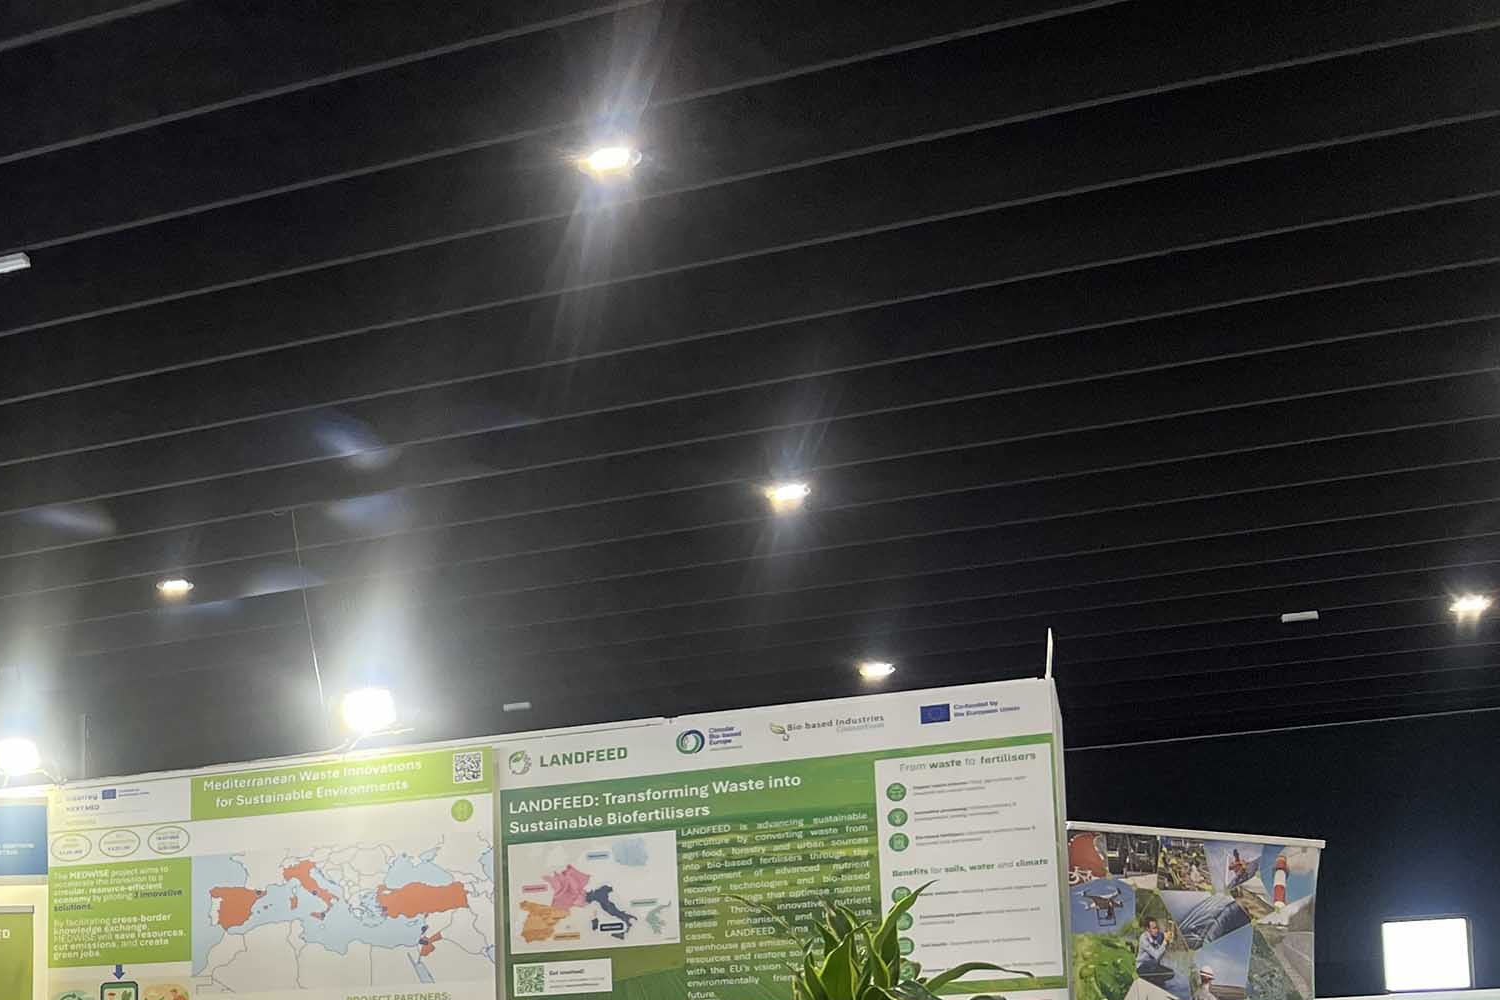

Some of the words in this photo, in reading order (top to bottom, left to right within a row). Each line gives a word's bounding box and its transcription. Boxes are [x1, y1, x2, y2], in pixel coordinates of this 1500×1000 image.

[540, 747, 628, 768] LANDFEED
[930, 759, 961, 768] waste
[980, 754, 1036, 764] fertilisers
[203, 775, 295, 791] Mediterranean
[300, 769, 340, 781] Waste
[343, 762, 422, 777] Innovations
[216, 797, 233, 808] for
[236, 789, 312, 806] Sustainable
[316, 780, 409, 798] Environments
[509, 793, 599, 814] LANDFEED:
[603, 783, 709, 804] Transforming
[712, 777, 764, 794] Waste
[769, 773, 801, 788] into
[510, 812, 602, 833] Sustainable
[607, 805, 710, 824] Biofertilisers
